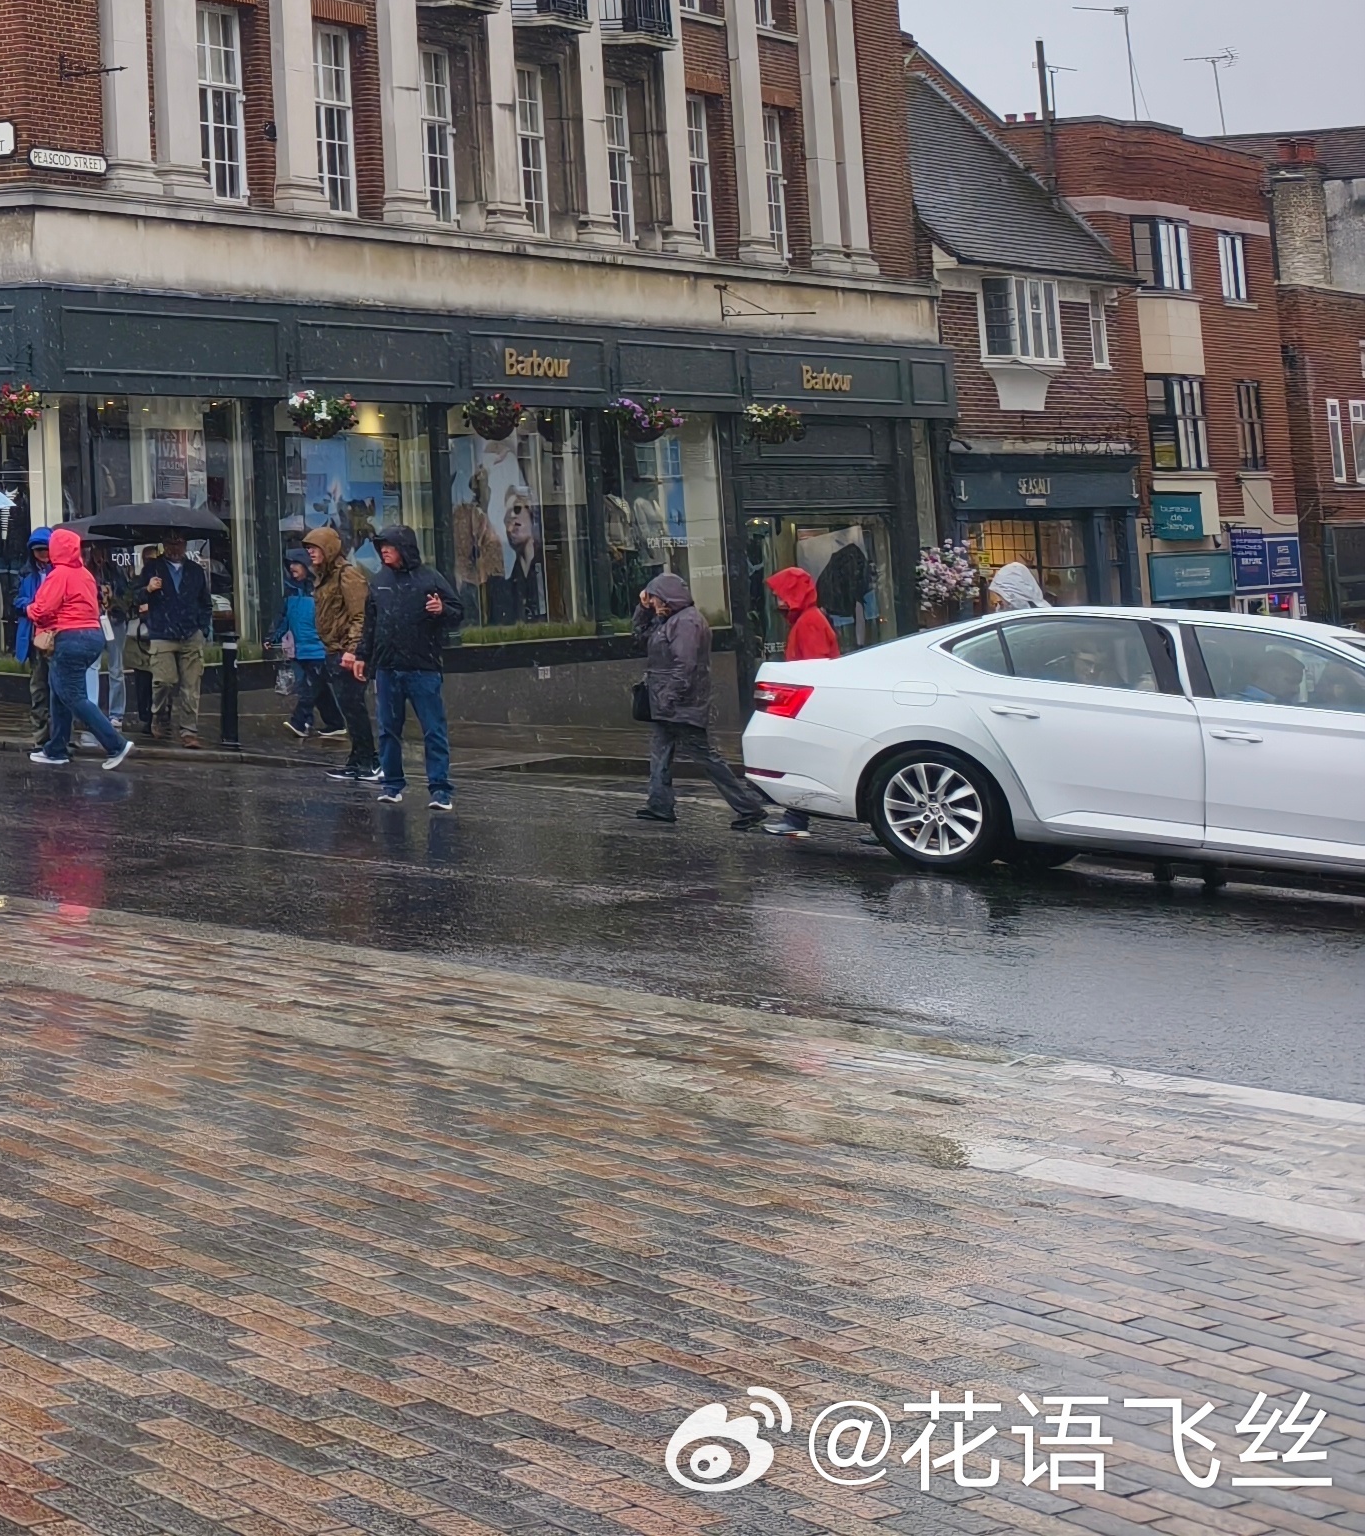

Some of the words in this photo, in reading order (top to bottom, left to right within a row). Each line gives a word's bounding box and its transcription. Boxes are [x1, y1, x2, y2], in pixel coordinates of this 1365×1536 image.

[33, 150, 71, 167] PEASCOD
[73, 156, 104, 171] STREET
[505, 347, 571, 378] Barbour
[802, 364, 853, 392] Barbour
